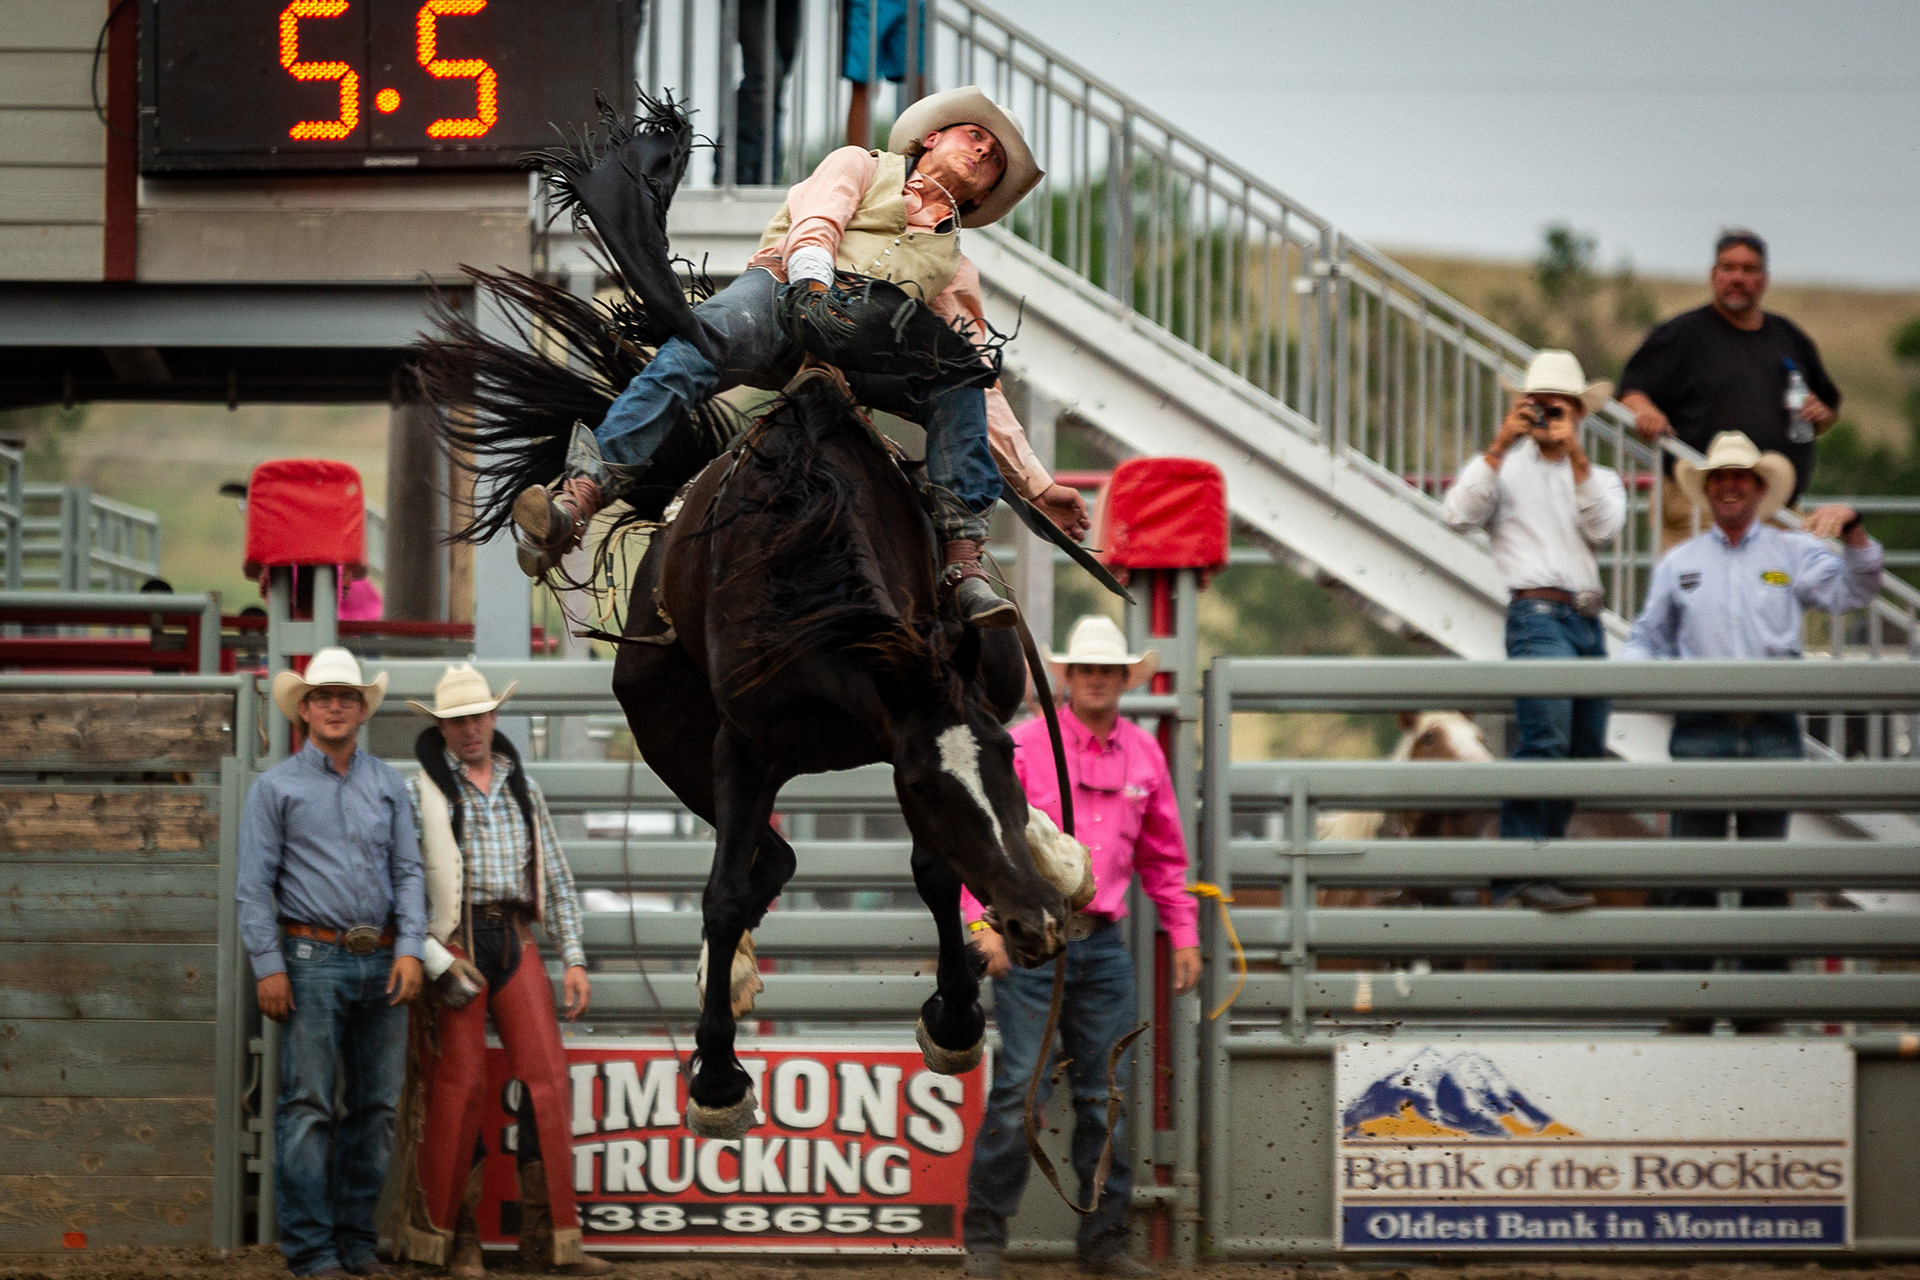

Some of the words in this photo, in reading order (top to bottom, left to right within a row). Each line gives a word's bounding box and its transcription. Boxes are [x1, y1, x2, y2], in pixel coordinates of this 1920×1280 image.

[279, 0, 498, 141] 5.5
[502, 1058, 965, 1154] IMONS
[570, 1137, 911, 1196] TRUCKING
[1343, 1153, 1488, 1190] Bank
[1495, 1157, 1543, 1190] of
[1550, 1159, 1619, 1190] the
[1632, 1152, 1844, 1190] Rockies
[576, 1205, 923, 1233] 38-8655
[1367, 1212, 1488, 1239] Oldest
[1496, 1212, 1598, 1238] Bank
[1606, 1211, 1643, 1238] in
[1656, 1212, 1823, 1239] Montana
